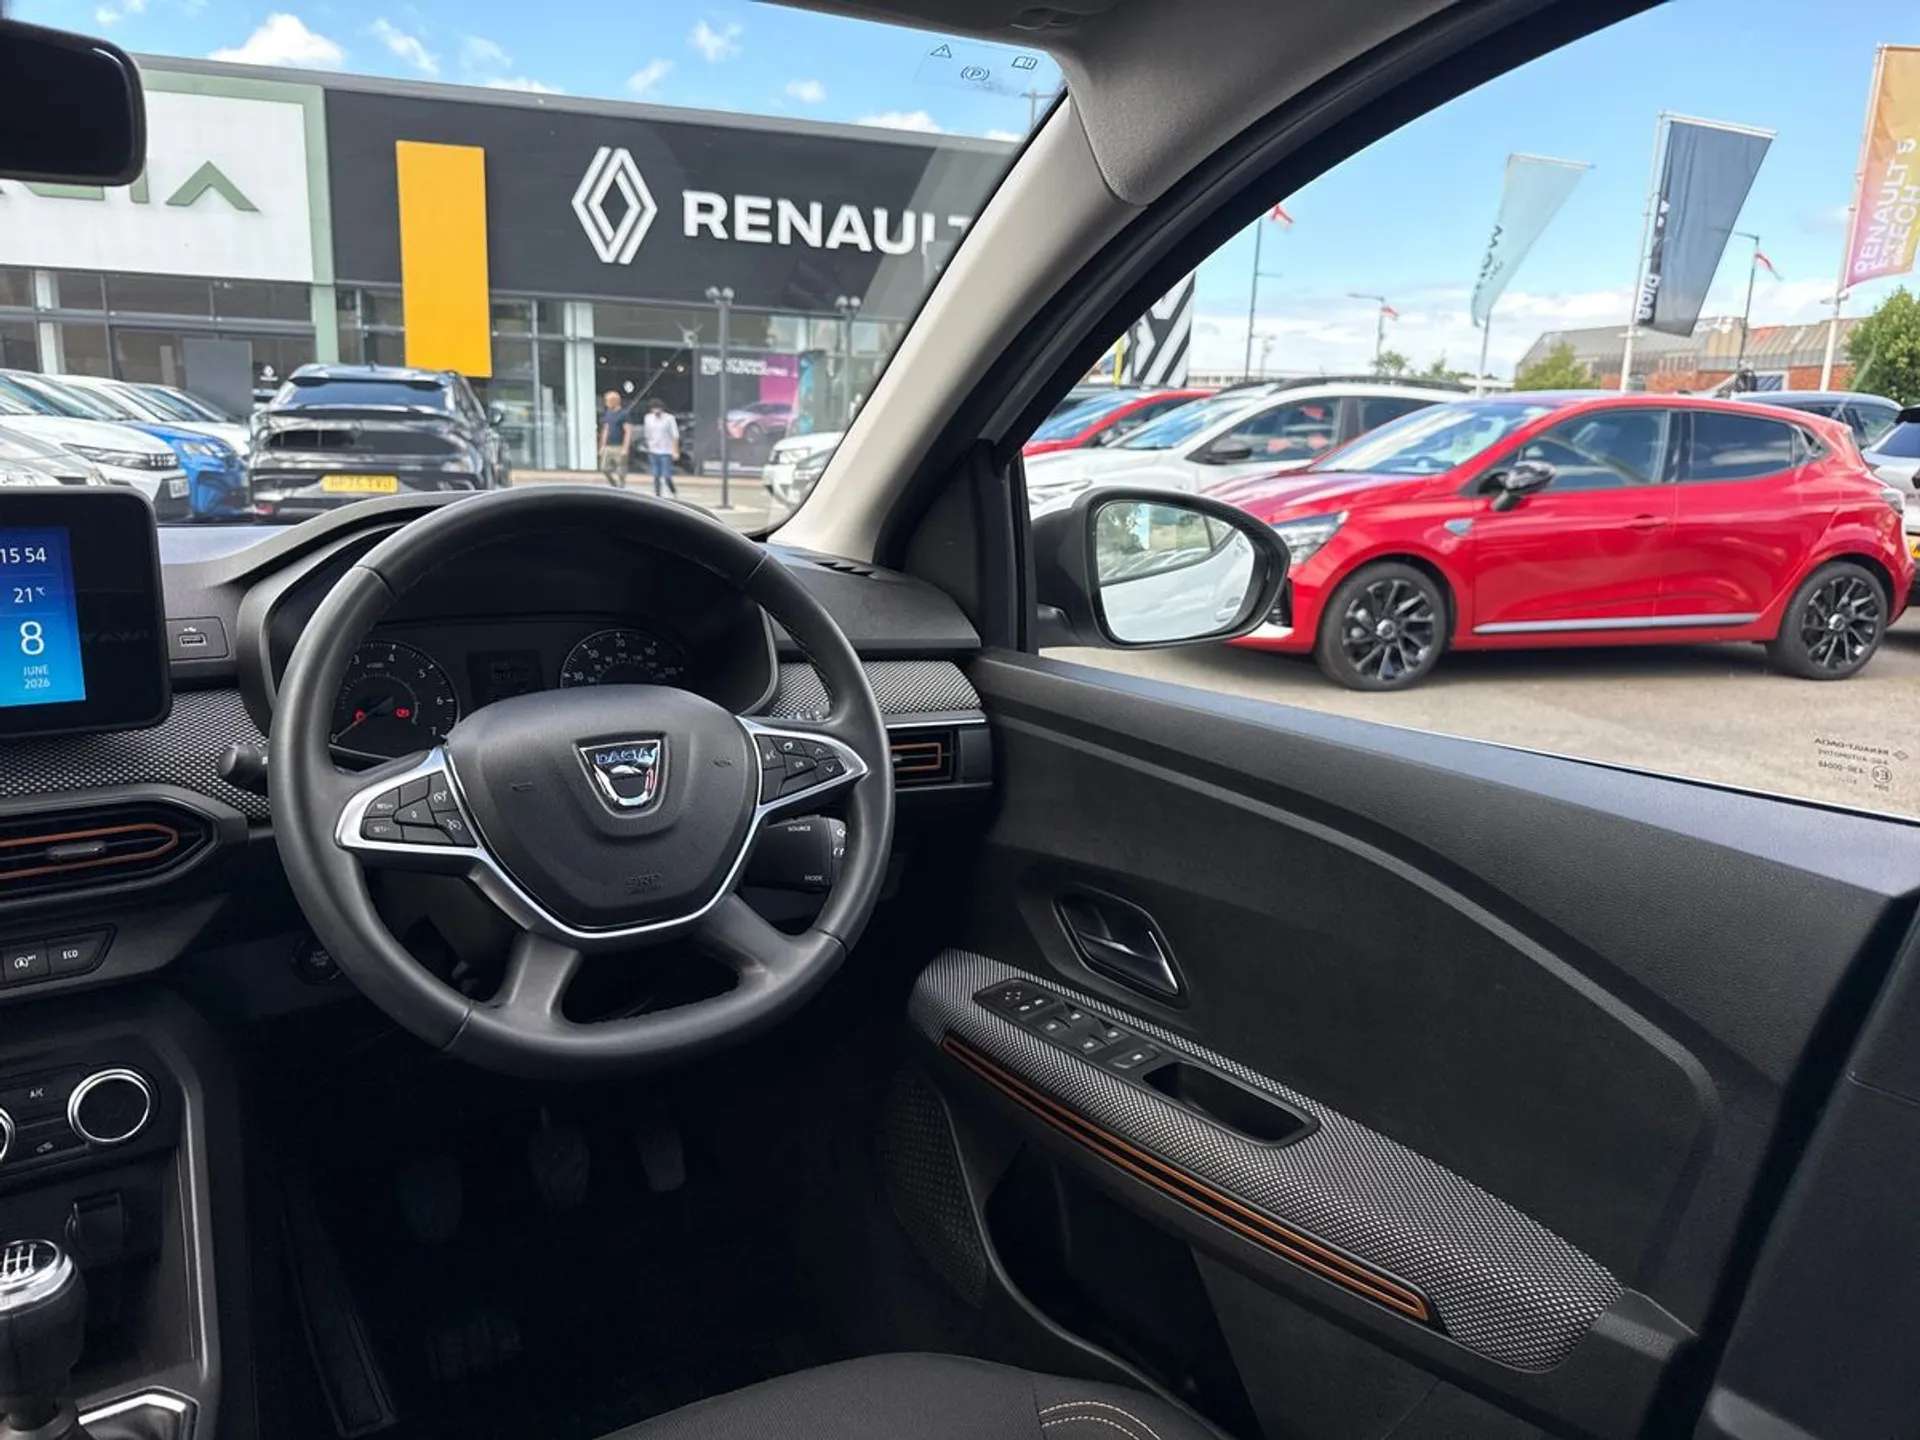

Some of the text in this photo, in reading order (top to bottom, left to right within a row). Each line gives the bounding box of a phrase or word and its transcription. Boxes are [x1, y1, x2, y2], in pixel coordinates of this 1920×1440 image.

[1854, 158, 1908, 274] RENAULT
[25, 547, 47, 563] 54
[20, 620, 44, 656] 8
[23, 664, 49, 677] JUNE
[24, 678, 51, 690] 2026
[62, 949, 79, 960] ECO
